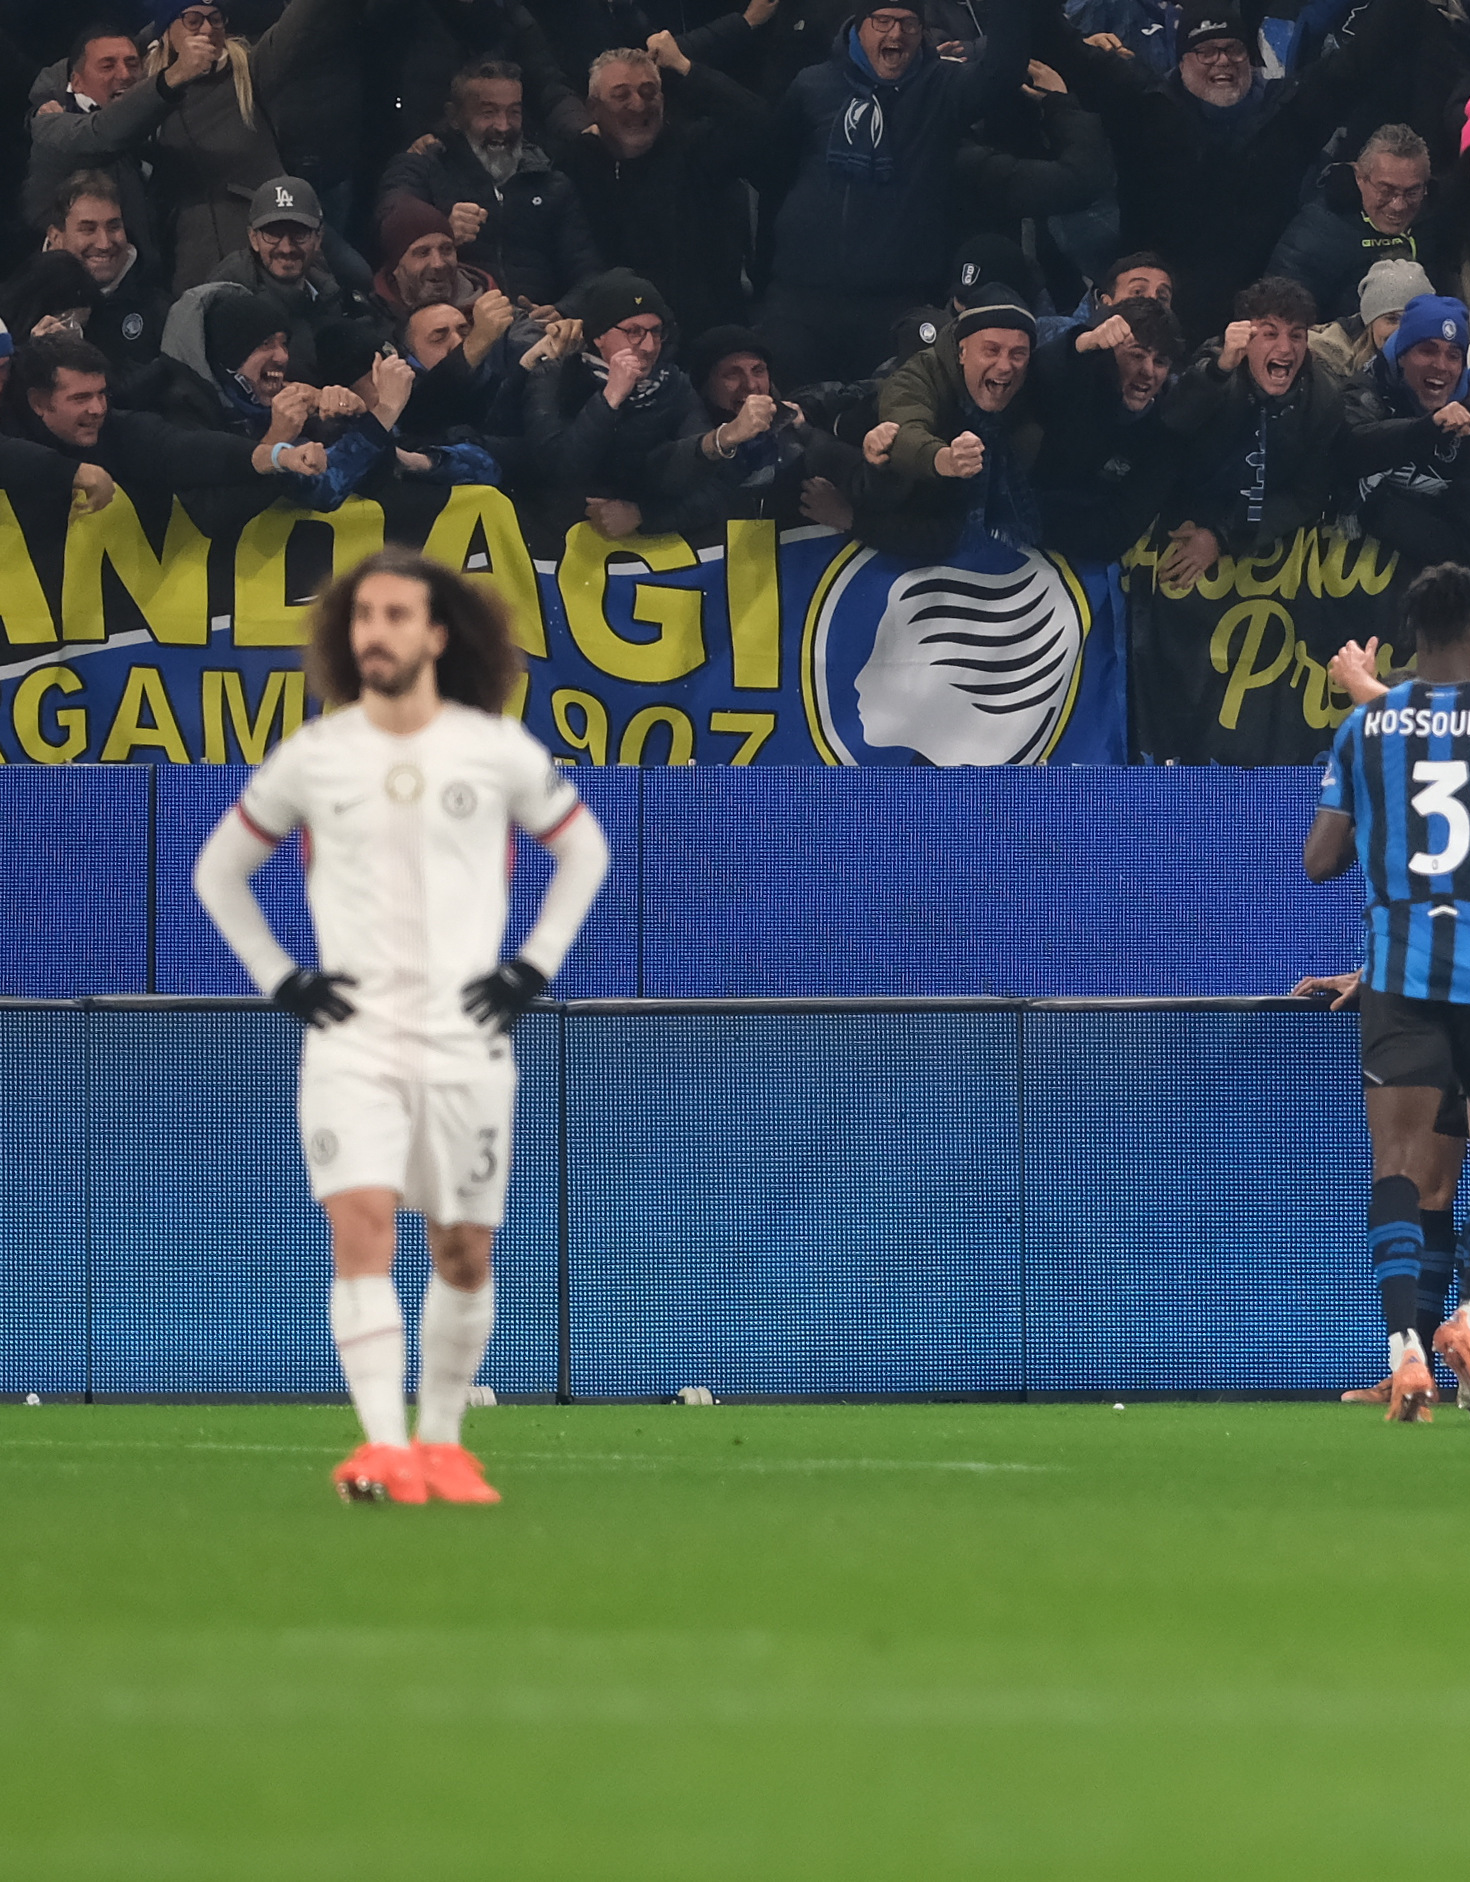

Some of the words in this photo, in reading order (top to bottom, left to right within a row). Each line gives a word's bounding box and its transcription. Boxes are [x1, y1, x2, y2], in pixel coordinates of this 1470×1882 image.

[274, 186, 294, 207] LA
[0, 665, 312, 764] GAM
[502, 672, 775, 766] 907
[469, 1126, 498, 1184] 3
